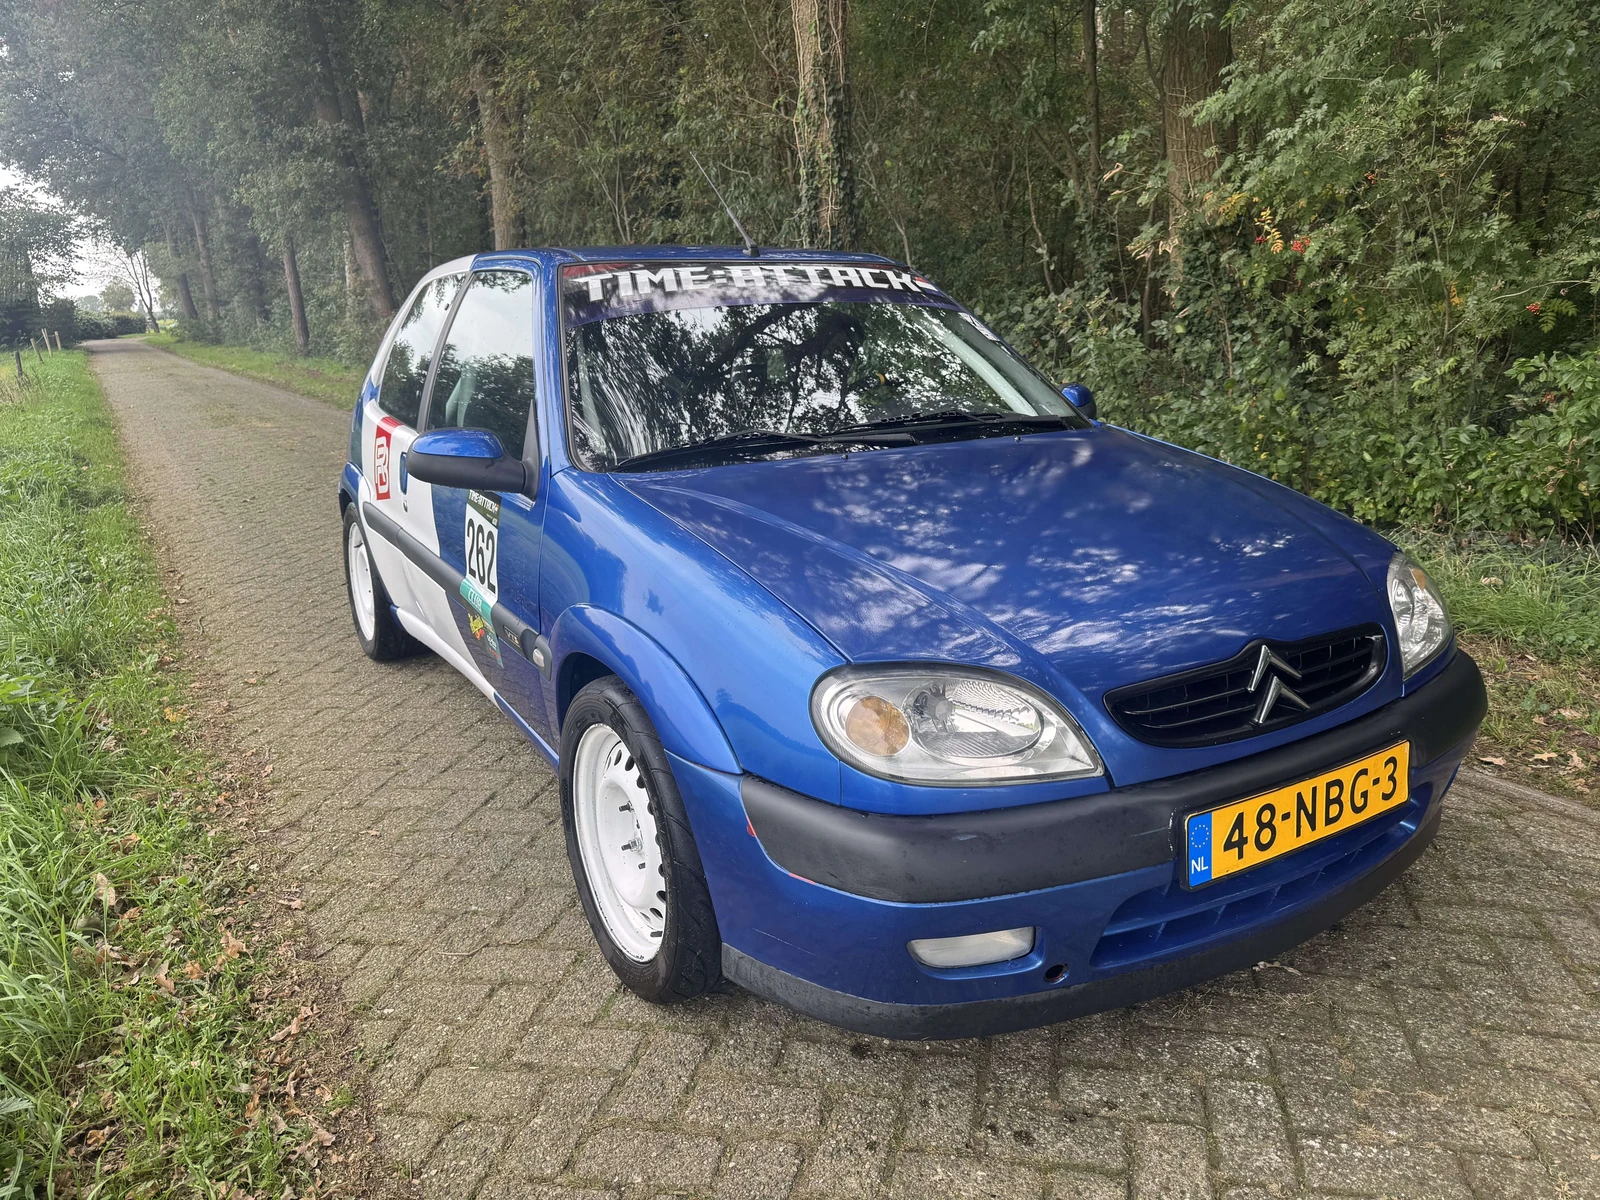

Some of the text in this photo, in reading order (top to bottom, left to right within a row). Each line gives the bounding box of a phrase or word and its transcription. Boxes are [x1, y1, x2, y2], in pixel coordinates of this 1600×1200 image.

[466, 518, 496, 595] 262
[1223, 756, 1398, 860] 48-NBG-3
[1191, 856, 1209, 875] NL
